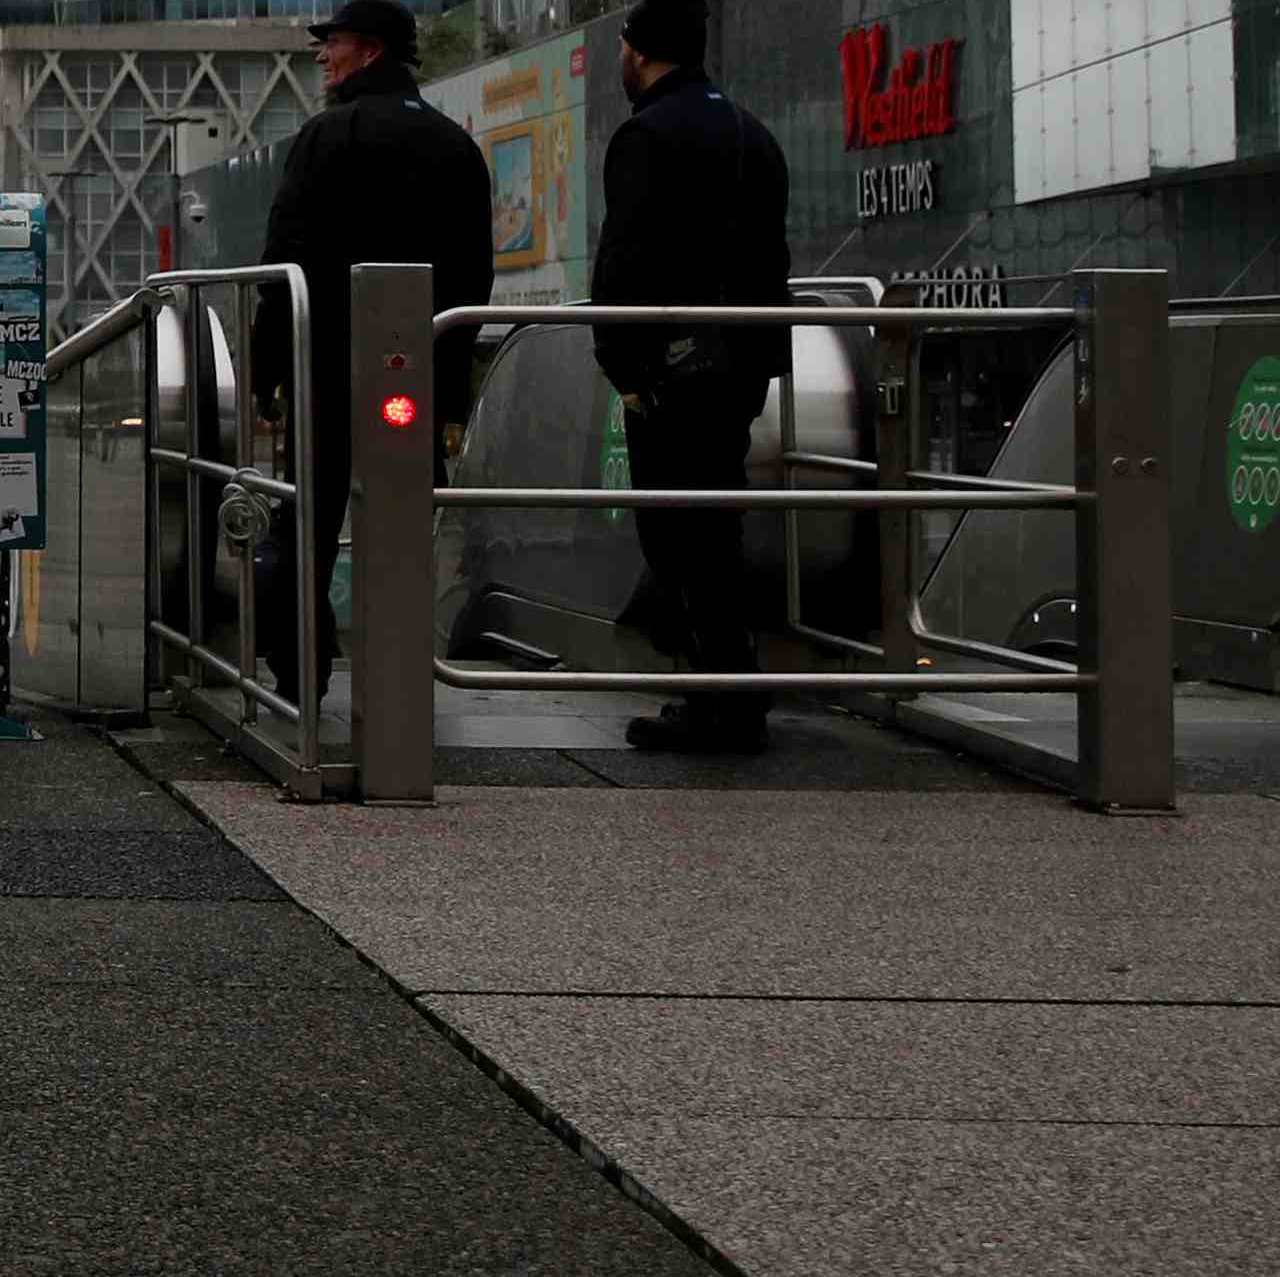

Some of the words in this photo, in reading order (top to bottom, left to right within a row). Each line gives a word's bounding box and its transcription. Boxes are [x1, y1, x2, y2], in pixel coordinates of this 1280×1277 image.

[856, 167, 878, 217] LES
[880, 165, 888, 215] 4
[890, 159, 934, 213] TEMPS
[891, 264, 1001, 308] PHORA
[0, 323, 40, 342] MCZ
